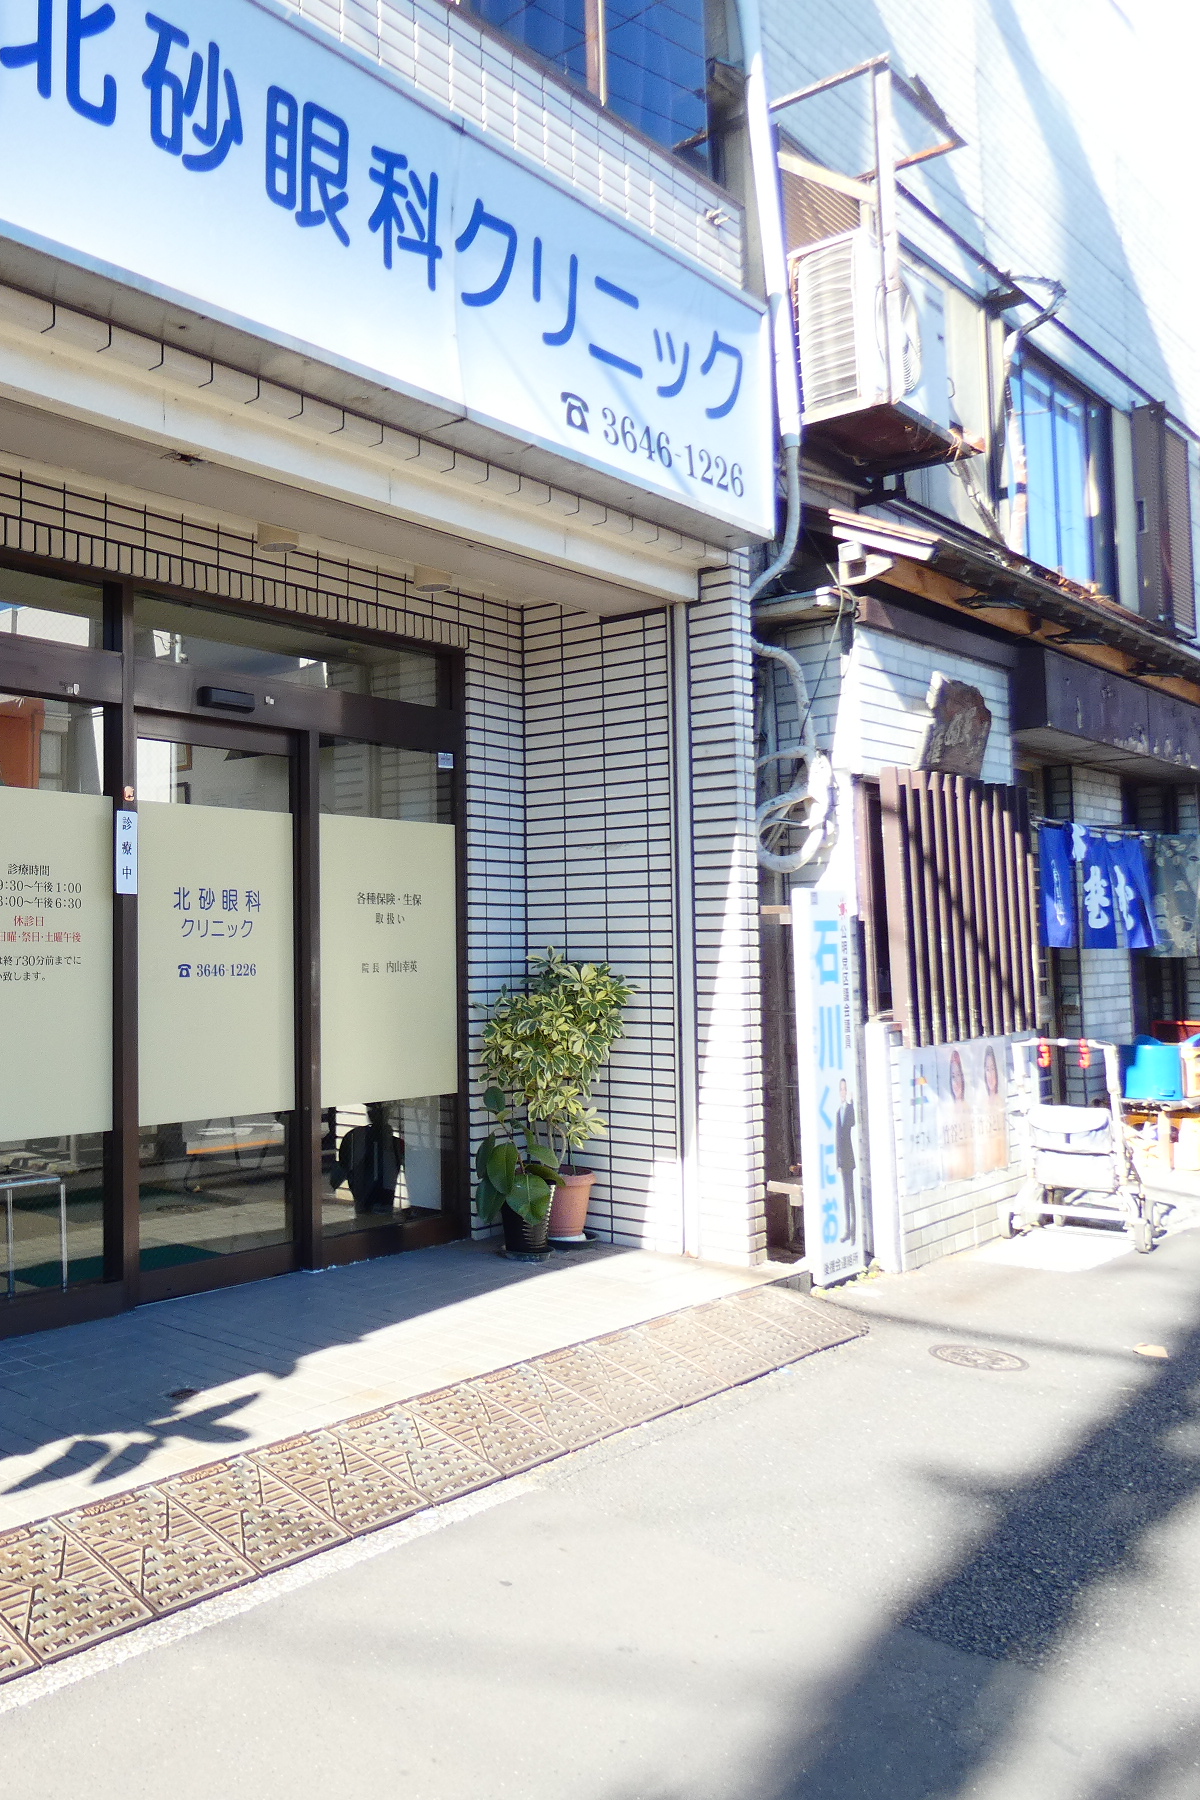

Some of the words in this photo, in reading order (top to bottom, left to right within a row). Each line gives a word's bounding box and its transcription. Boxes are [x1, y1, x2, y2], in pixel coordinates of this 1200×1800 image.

[0, 0, 744, 419] 北砂眼科クリニック
[601, 407, 745, 498] 3646-1226
[122, 816, 133, 880] 診療中
[7, 863, 51, 877] 診療時間
[173, 886, 261, 913] 北砂眼科
[13, 915, 45, 927] 休診日
[181, 918, 253, 938] クリニック
[375, 912, 405, 925] 取扱い
[196, 963, 257, 978] 3646-1226
